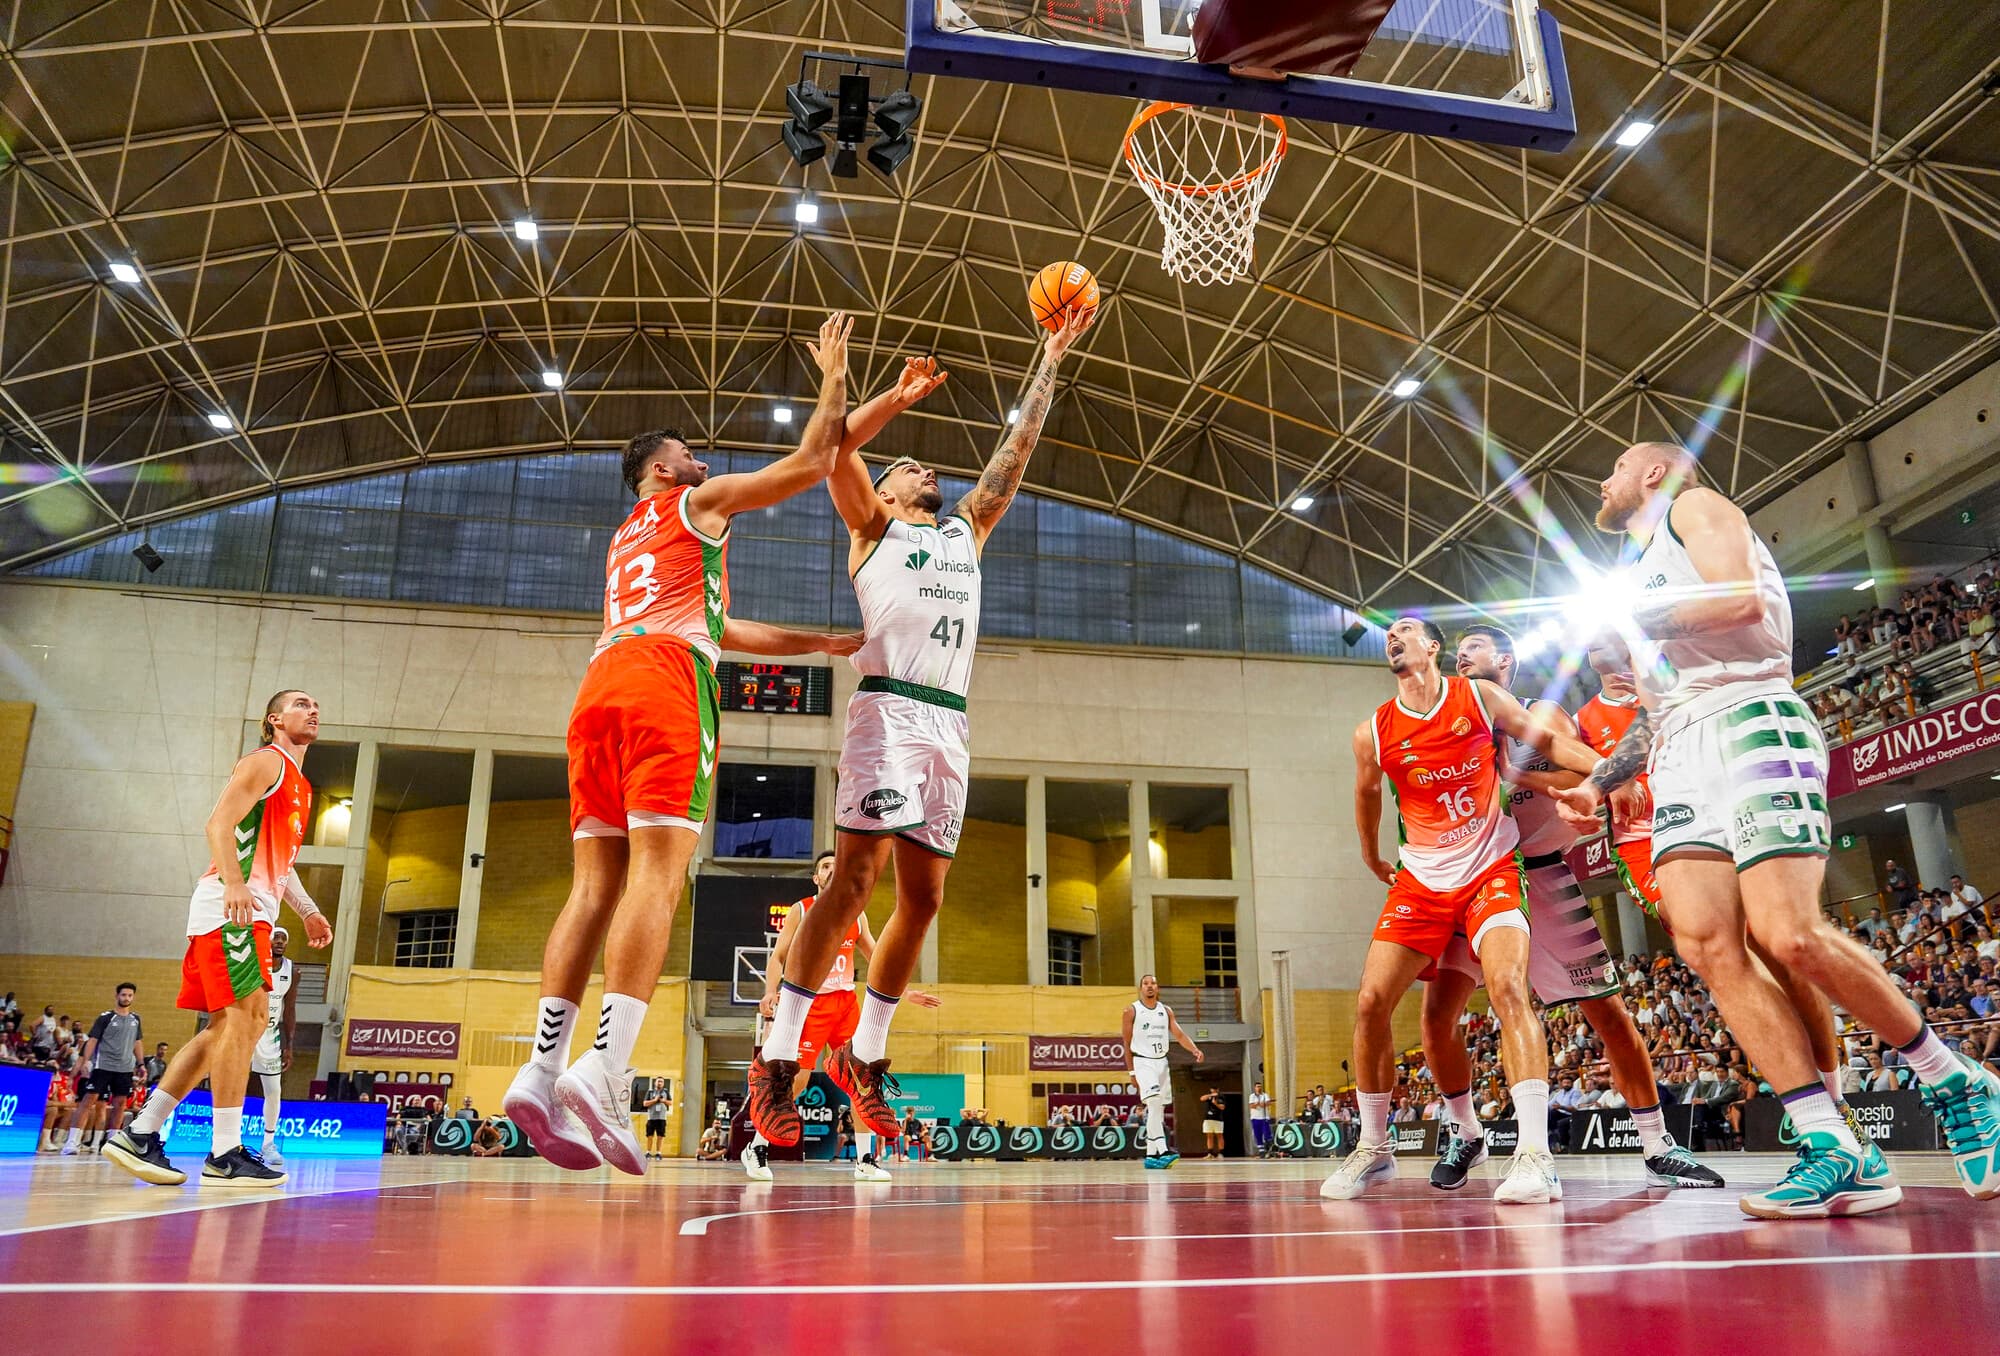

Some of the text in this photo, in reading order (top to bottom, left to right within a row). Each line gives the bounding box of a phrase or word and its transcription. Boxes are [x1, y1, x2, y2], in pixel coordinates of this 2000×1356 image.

[1961, 511, 1971, 524] 2
[606, 552, 660, 627] 13
[929, 615, 965, 650] 41
[743, 683, 758, 695] 27
[790, 686, 801, 697] 13
[1417, 757, 1480, 785] INSOLAC
[1857, 771, 1888, 787] Instituto
[1888, 758, 1925, 777] Municipal
[1925, 754, 1937, 765] de
[1937, 742, 1976, 761] Deportes
[1435, 786, 1476, 822] 16
[1654, 807, 1693, 828] adesa
[375, 1027, 457, 1047] IMDECO
[1054, 1043, 1125, 1060] IMDECO
[798, 1105, 832, 1122] lucía
[308, 1117, 342, 1139] 482
[1610, 1117, 1637, 1131] Junta
[1608, 1132, 1621, 1148] de
